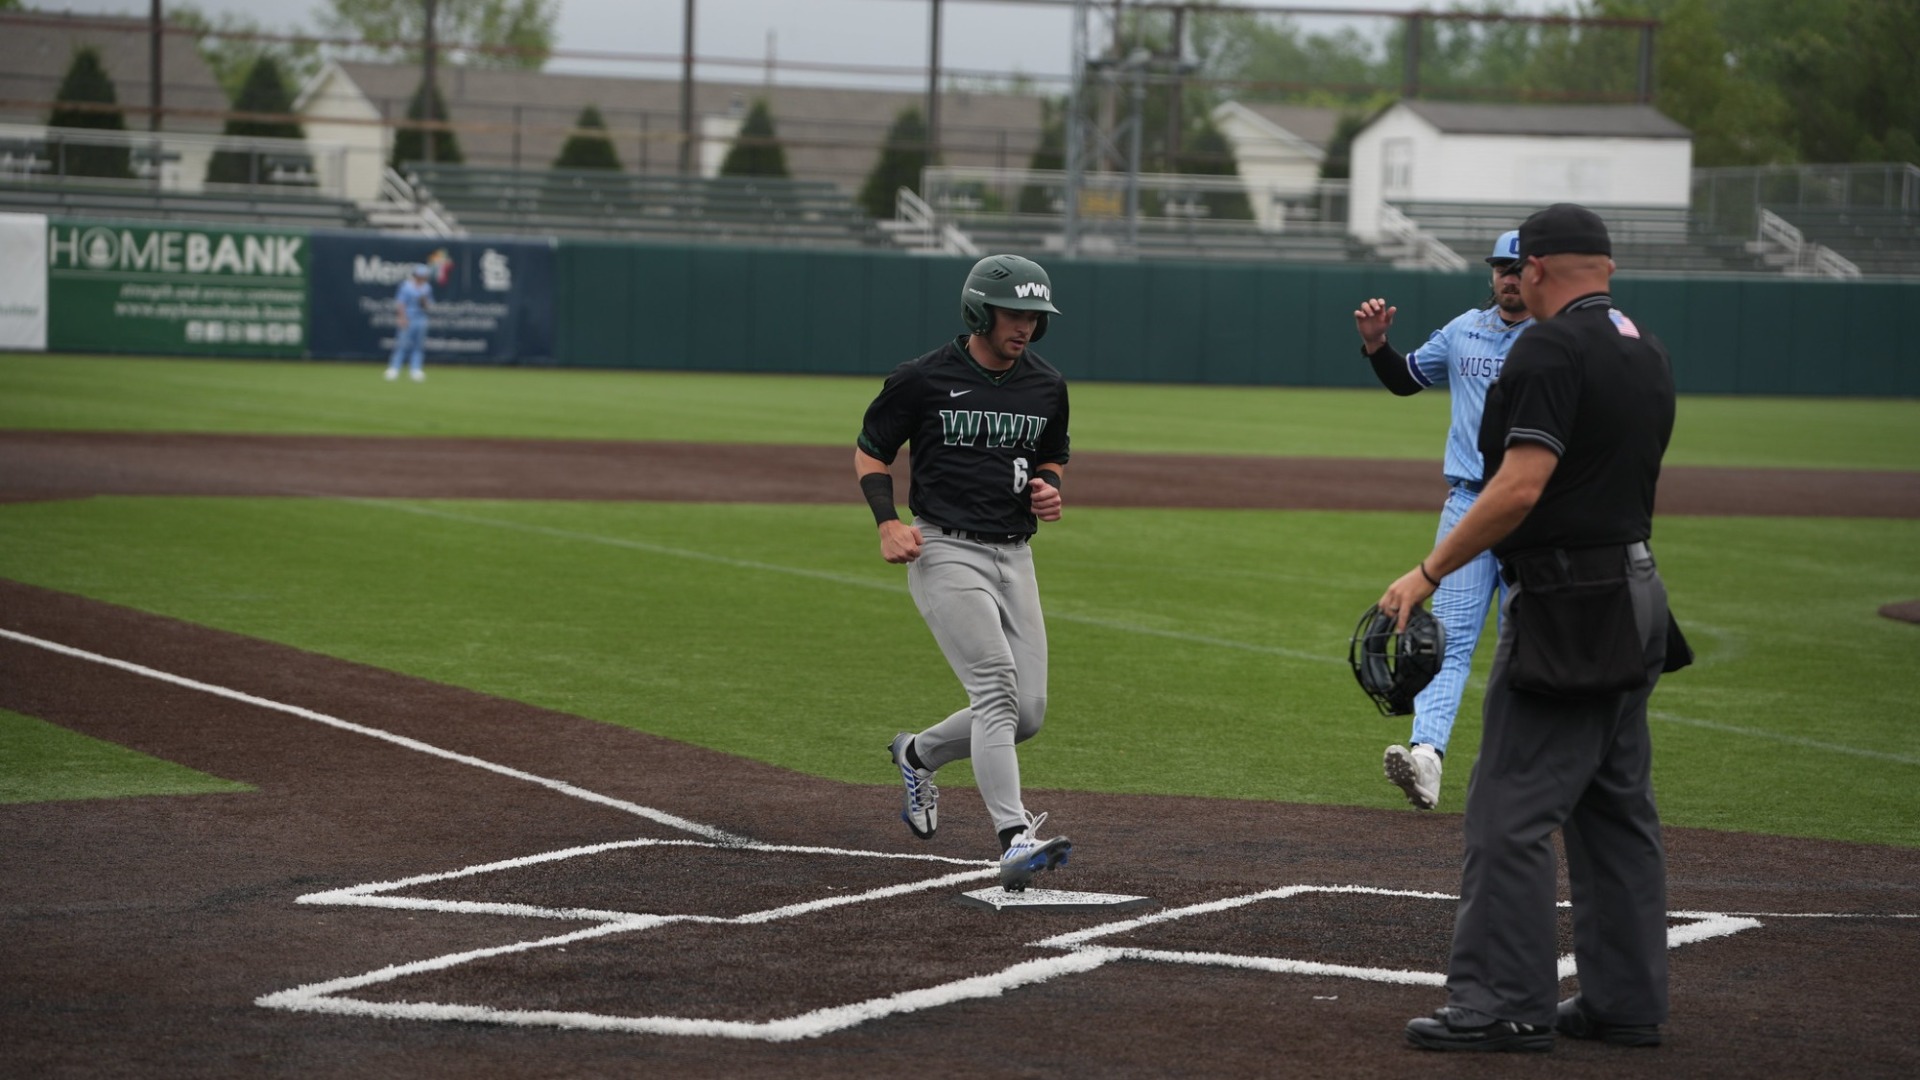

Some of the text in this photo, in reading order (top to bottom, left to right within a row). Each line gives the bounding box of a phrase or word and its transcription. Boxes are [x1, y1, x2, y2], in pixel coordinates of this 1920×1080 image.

[50, 226, 304, 276] HOMEBANK
[1014, 282, 1051, 302] WWU
[939, 409, 1048, 452] WWU
[1013, 457, 1028, 494] 6
